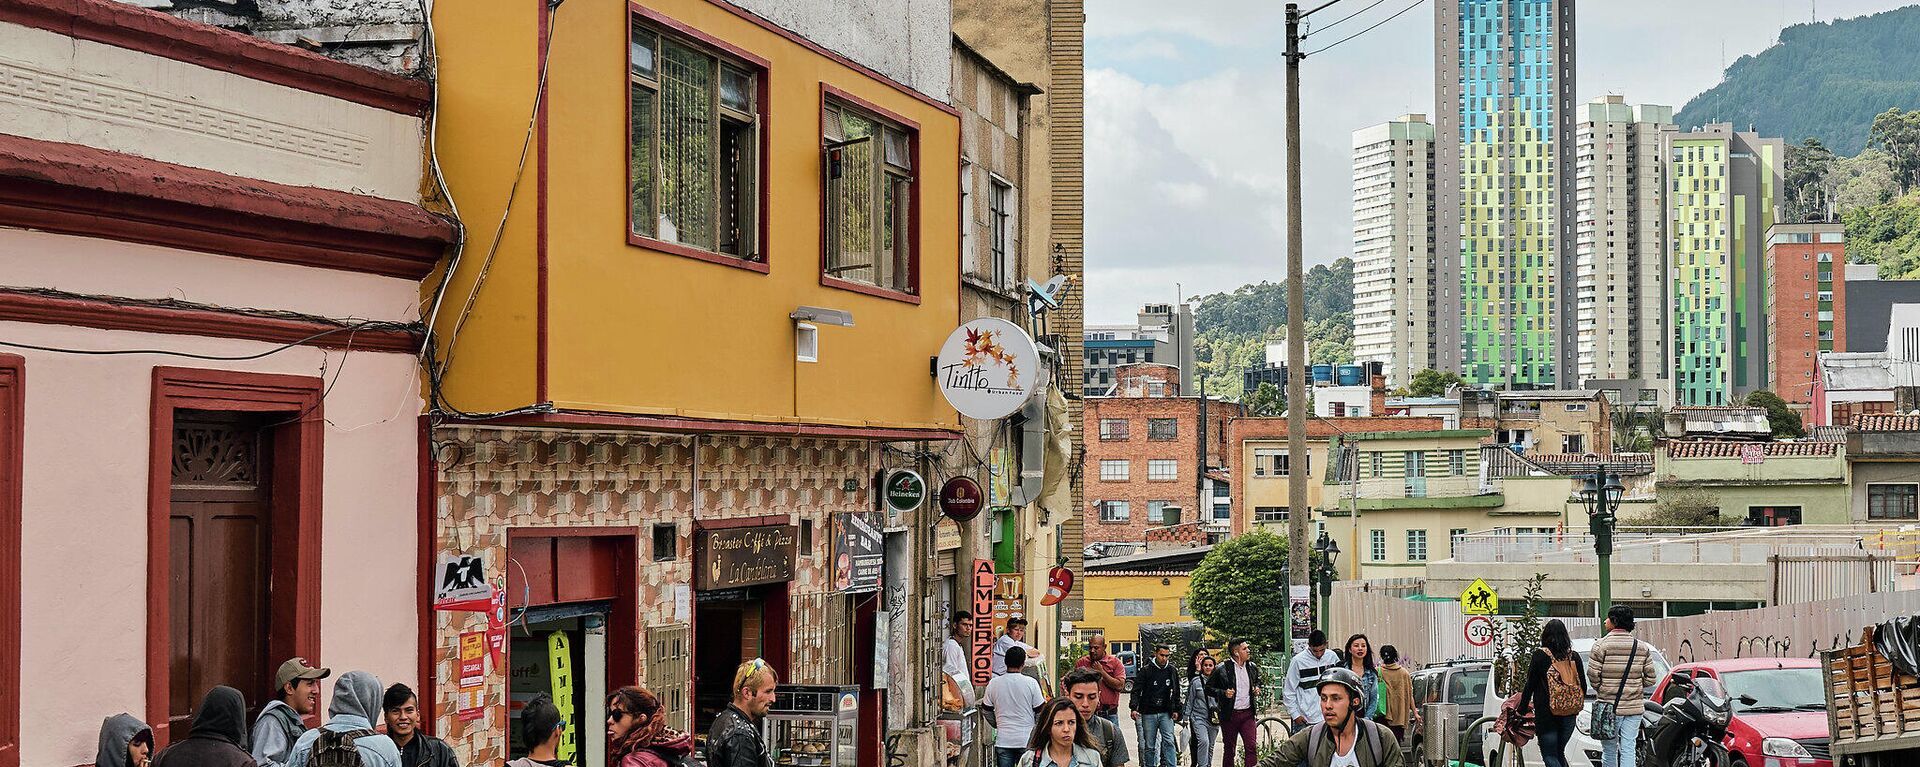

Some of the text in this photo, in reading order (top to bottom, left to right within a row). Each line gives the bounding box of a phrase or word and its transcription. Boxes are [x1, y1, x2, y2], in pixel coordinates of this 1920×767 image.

[942, 364, 989, 391] Tintto
[889, 490, 920, 498] Heineken
[773, 529, 792, 550] Pizza
[728, 563, 740, 584] La
[974, 561, 993, 684] ALMUERZOS
[1471, 626, 1487, 637] 30
